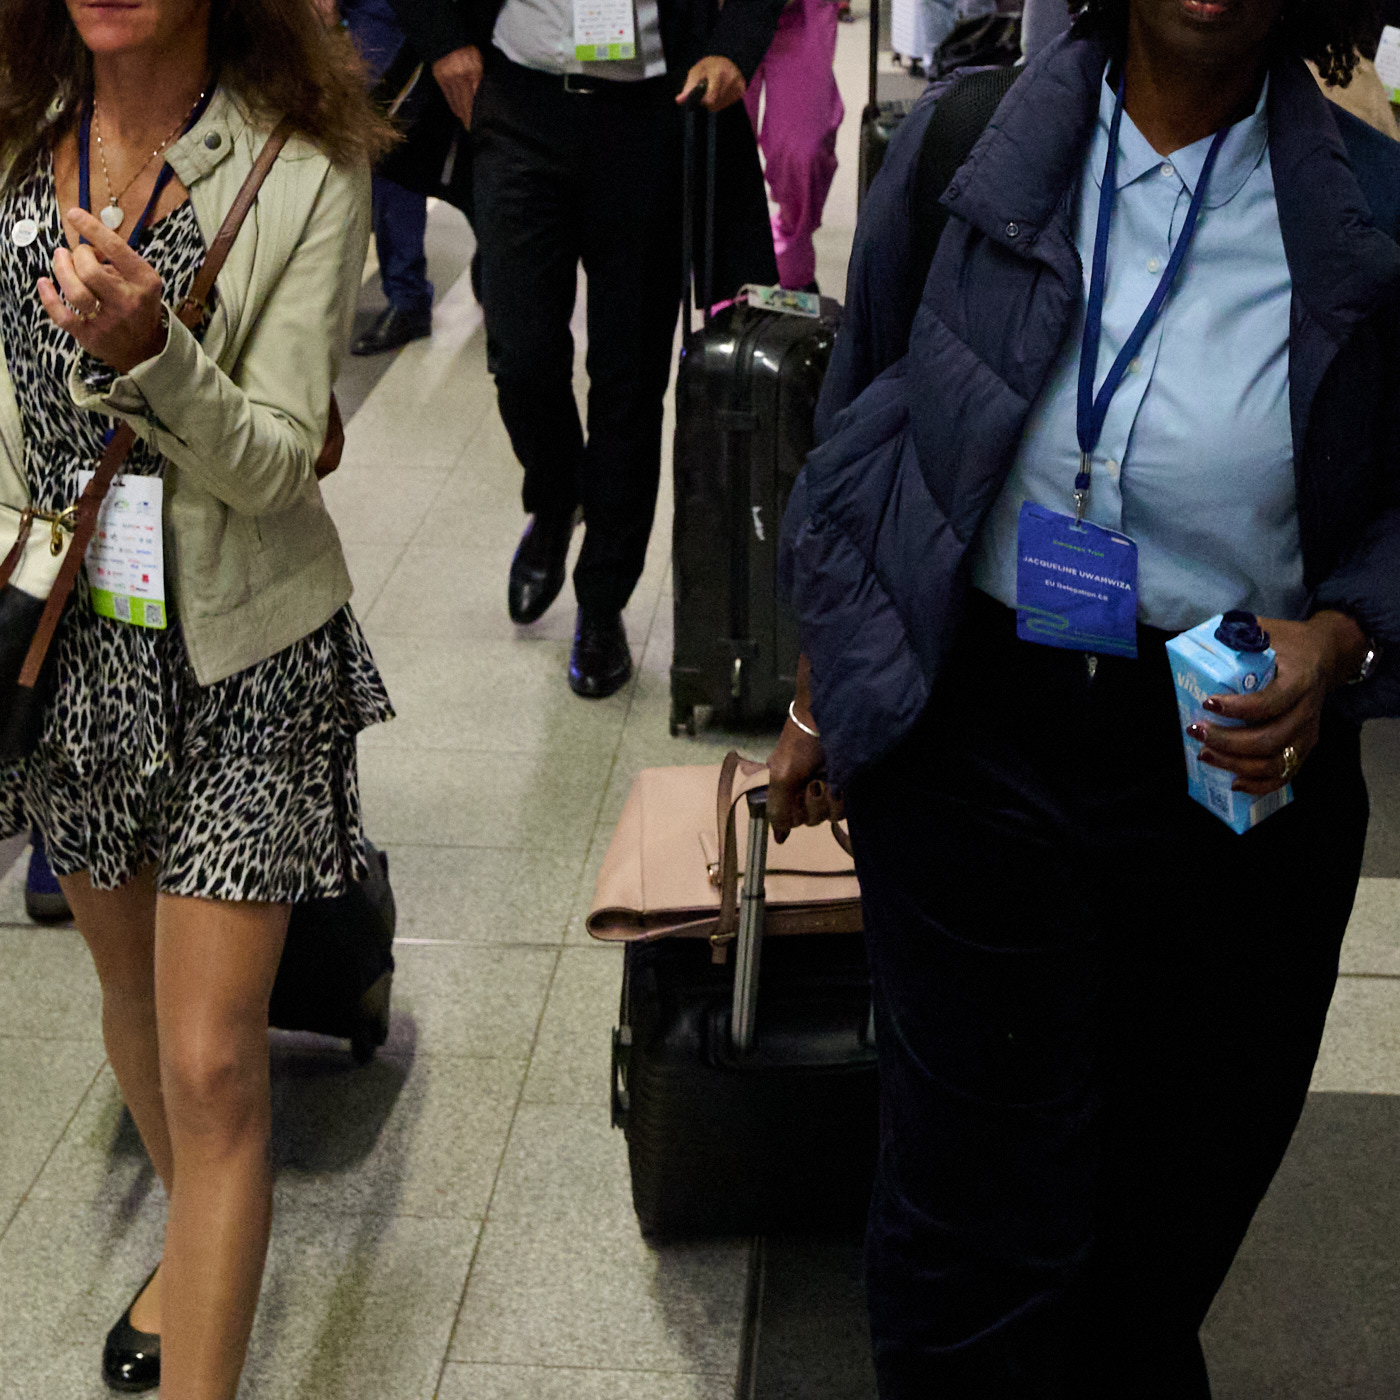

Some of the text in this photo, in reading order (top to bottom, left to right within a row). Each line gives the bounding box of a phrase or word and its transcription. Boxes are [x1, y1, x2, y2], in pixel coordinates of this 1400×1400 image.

[1023, 555, 1078, 576] JACQUELINE
[1044, 579, 1056, 588] EU
[1056, 581, 1097, 598] Delegation
